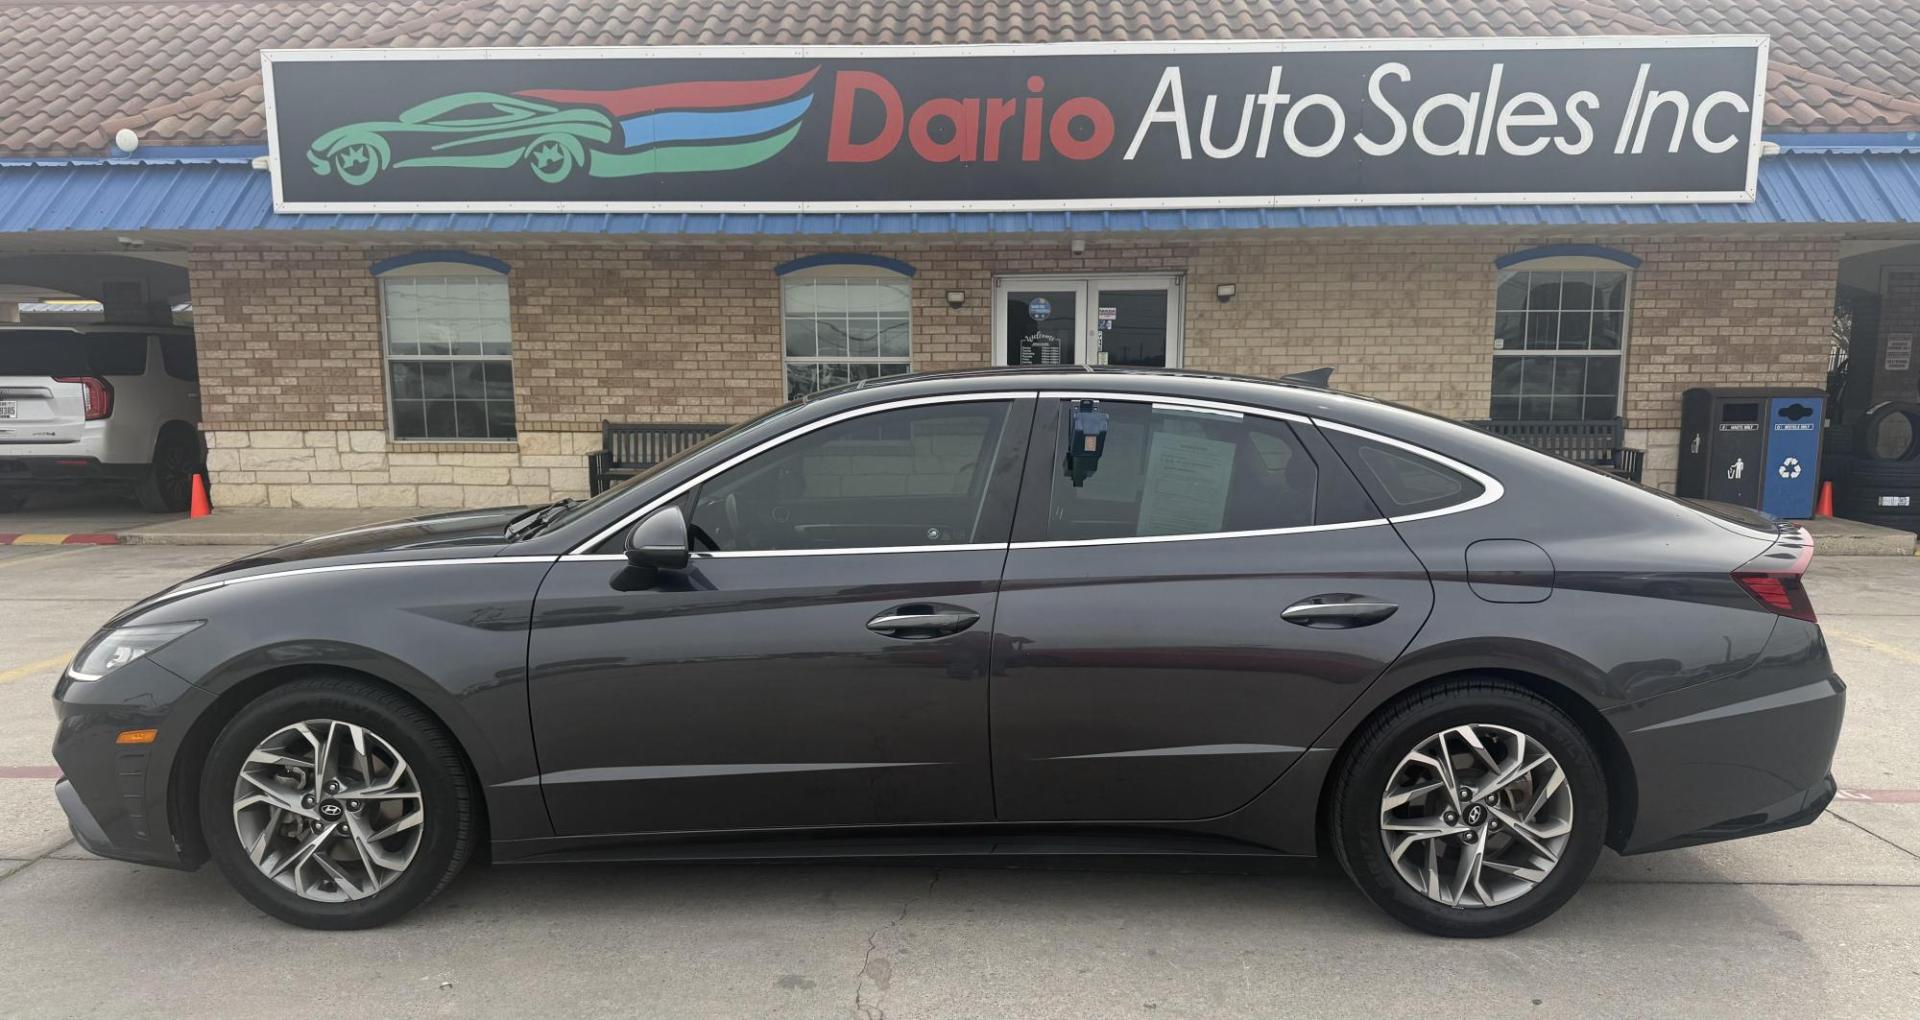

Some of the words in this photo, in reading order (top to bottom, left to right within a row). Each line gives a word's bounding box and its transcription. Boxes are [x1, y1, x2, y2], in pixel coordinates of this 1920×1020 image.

[827, 70, 1116, 163] Dario
[1614, 63, 1750, 155] Inc
[1025, 331, 1054, 342] Welcome
